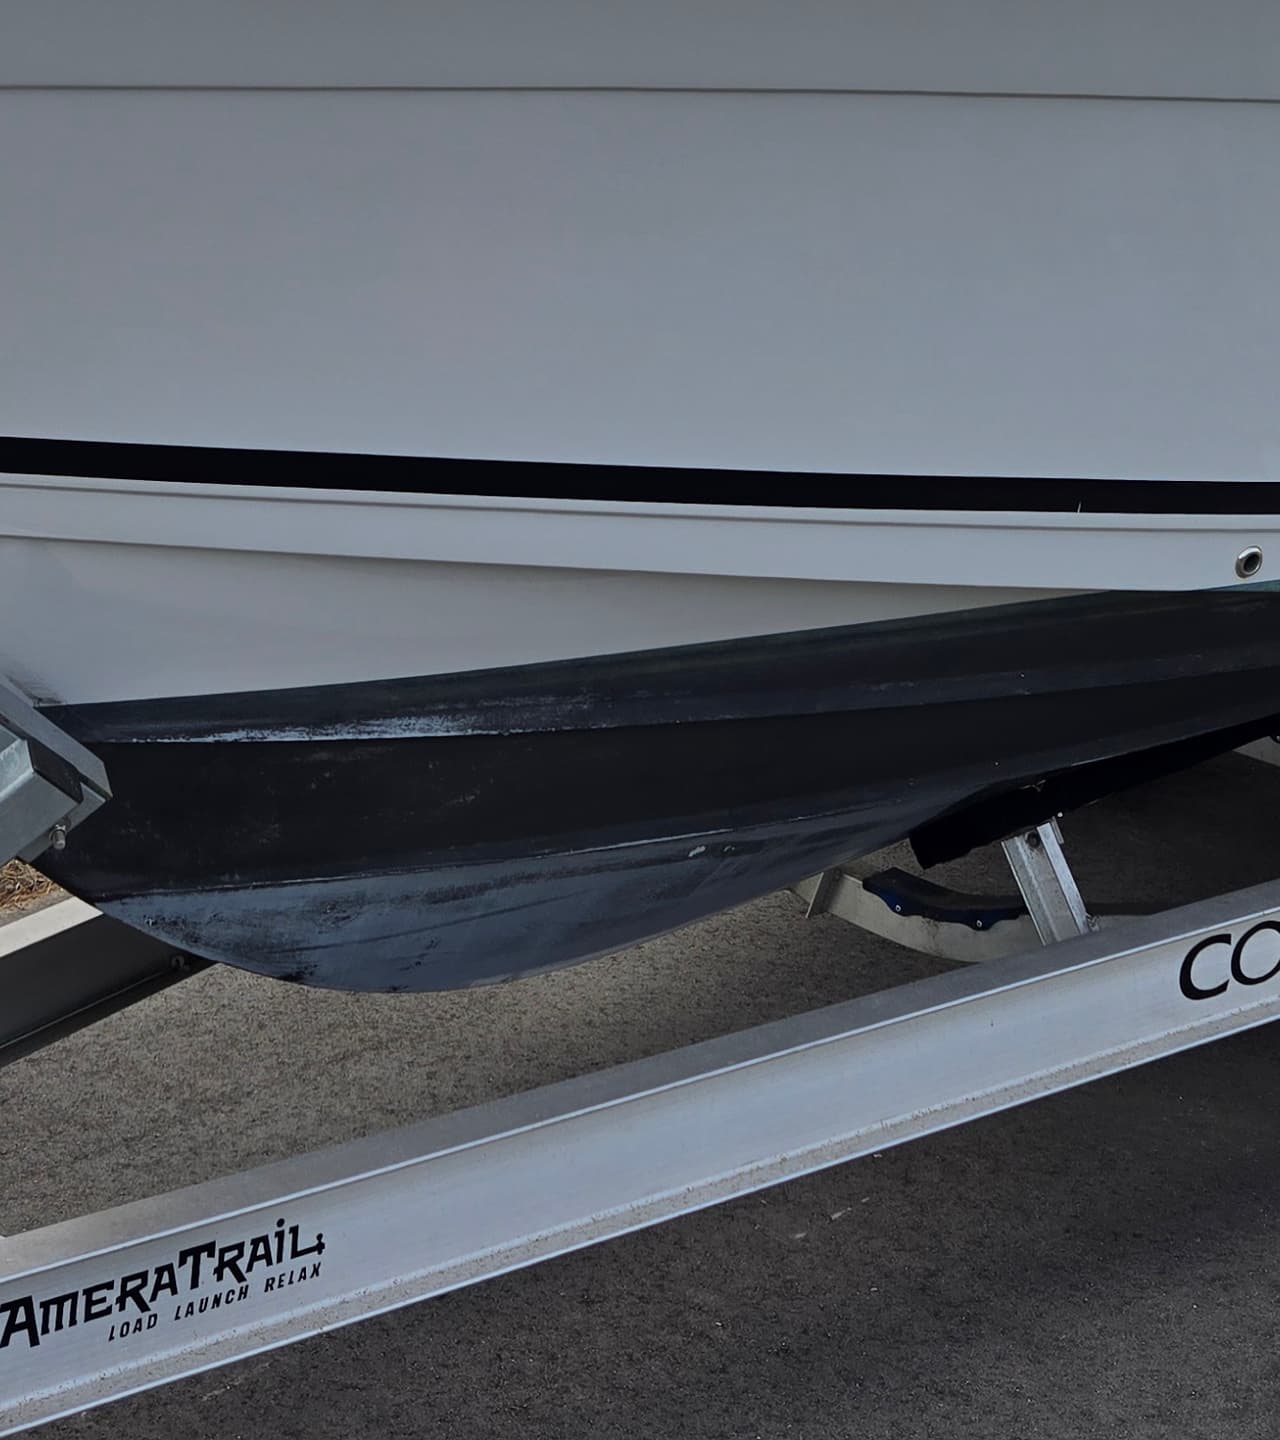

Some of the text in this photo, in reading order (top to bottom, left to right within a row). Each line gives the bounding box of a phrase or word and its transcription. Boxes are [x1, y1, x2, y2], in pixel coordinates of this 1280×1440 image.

[108, 1262, 322, 1342] LOAD LAUNCH RELAX
